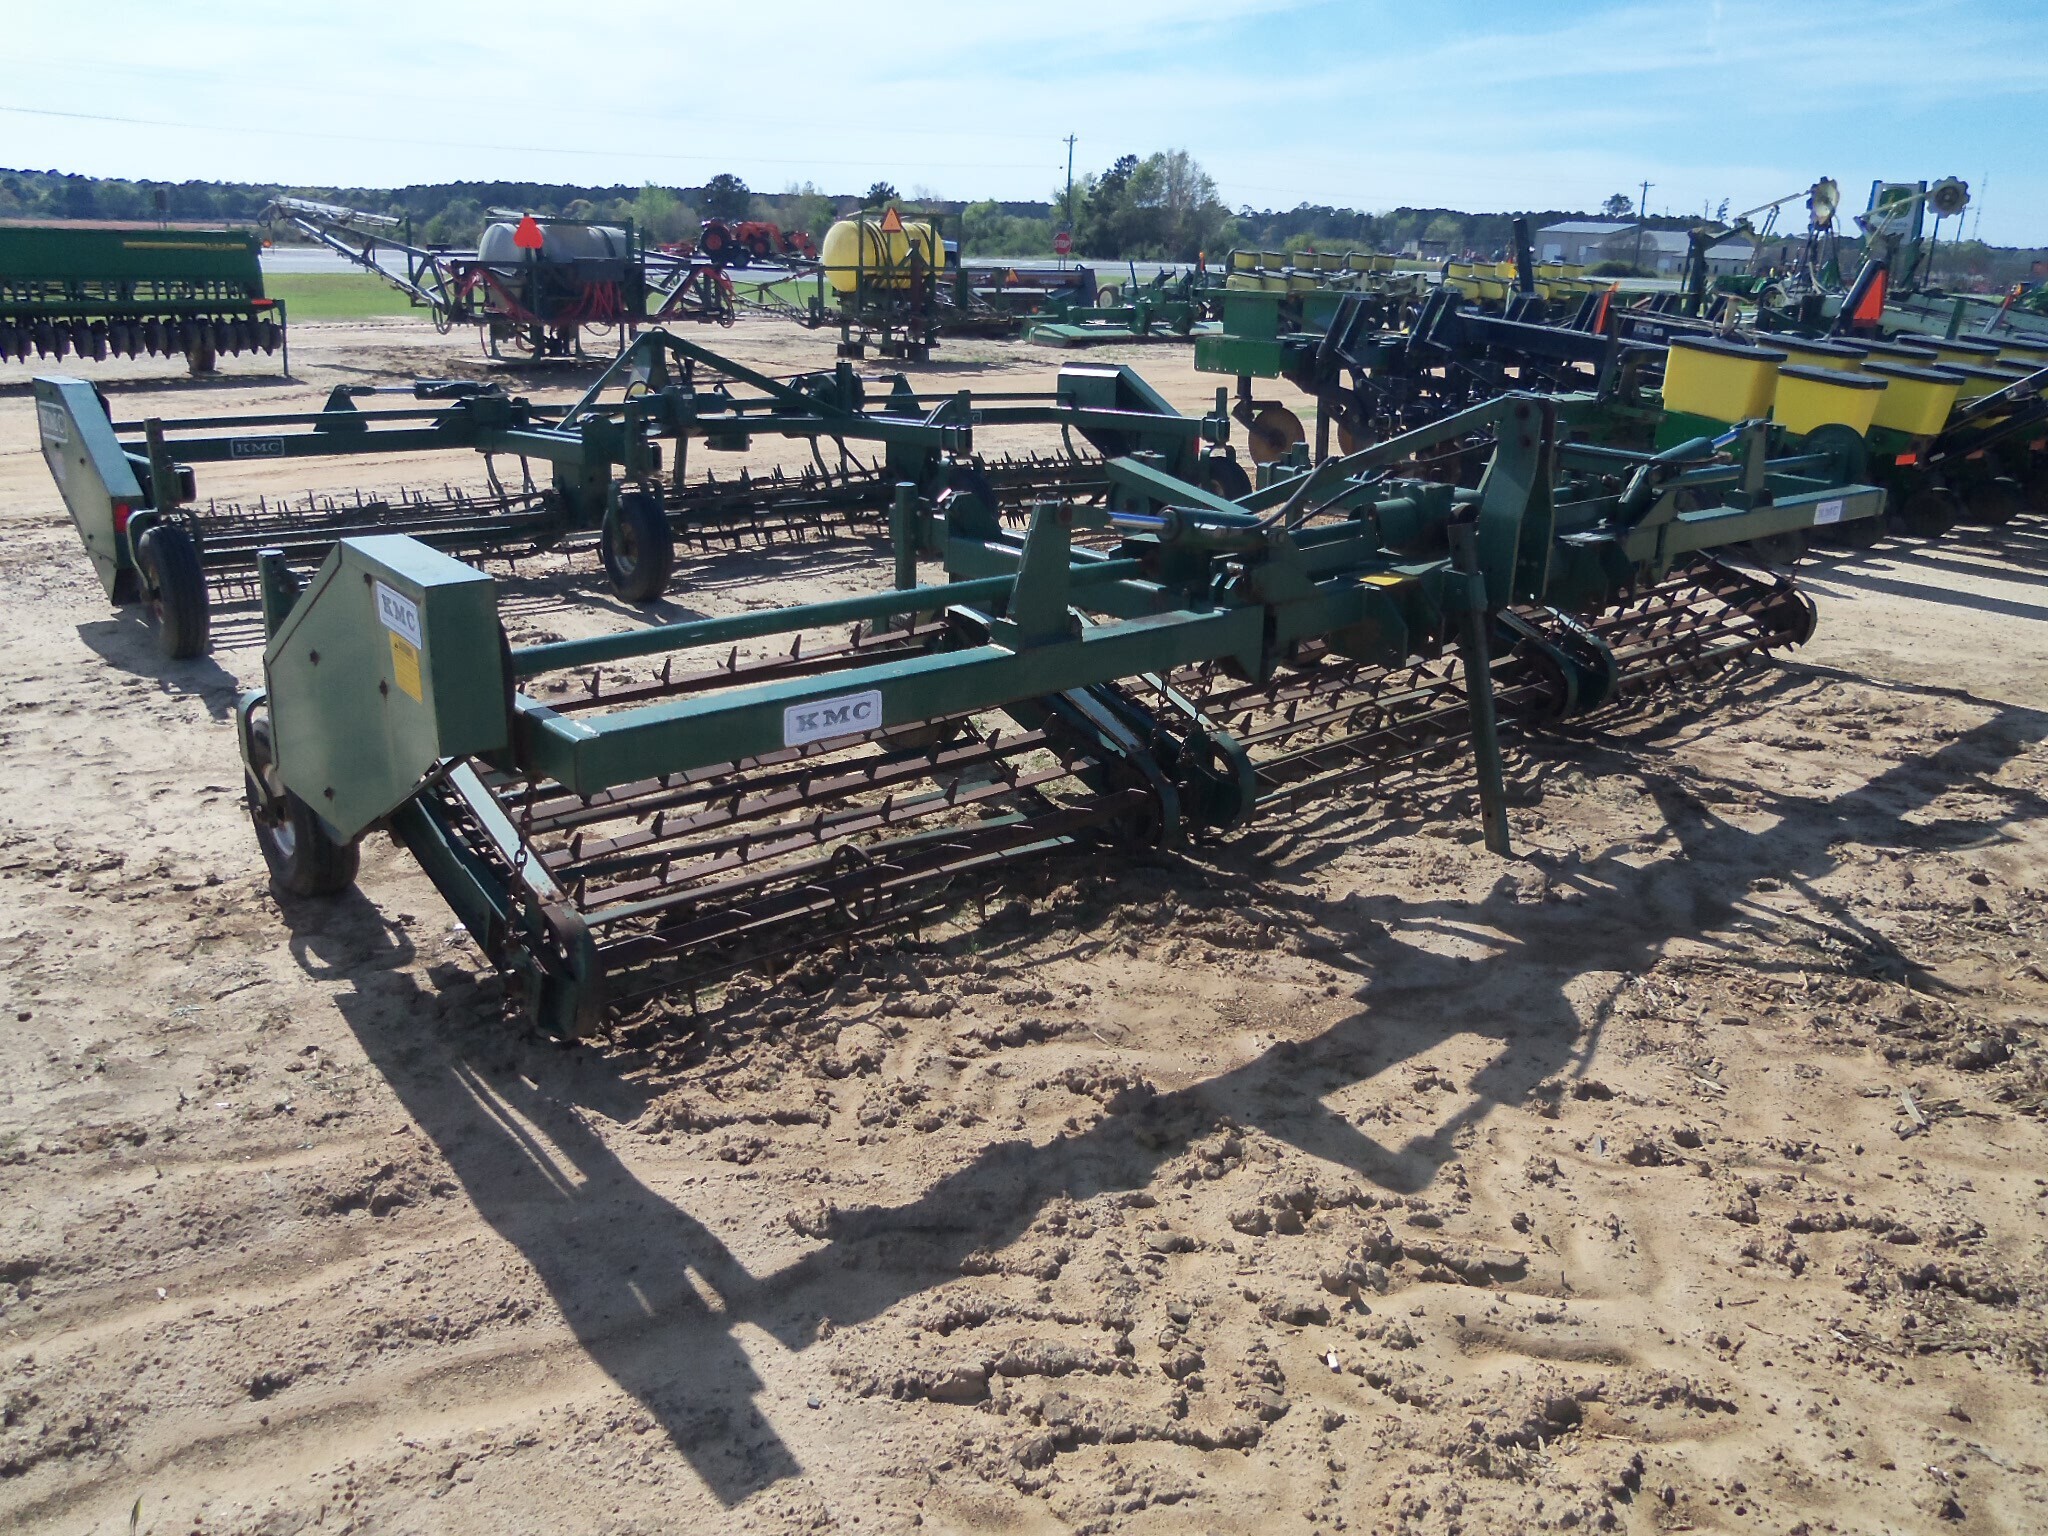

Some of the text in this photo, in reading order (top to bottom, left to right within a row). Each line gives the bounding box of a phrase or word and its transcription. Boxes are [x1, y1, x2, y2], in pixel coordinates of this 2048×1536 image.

[1055, 239, 1071, 249] STOP
[236, 442, 280, 454] KMC
[381, 593, 416, 632] KMC
[796, 701, 872, 733] KMC
